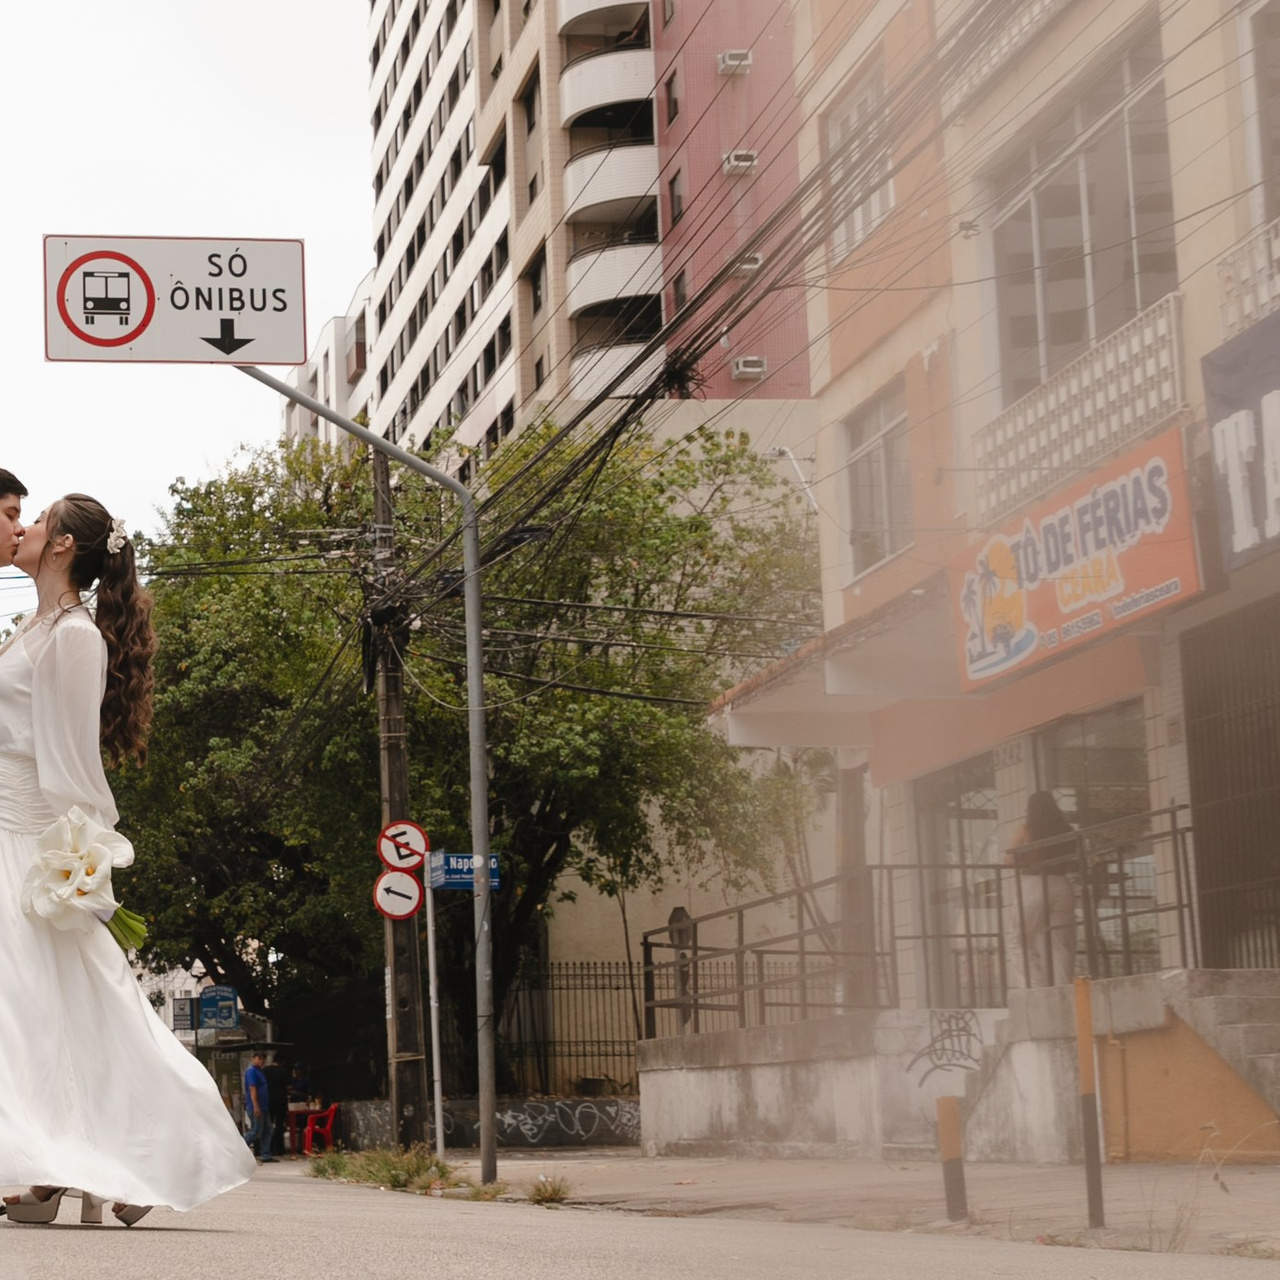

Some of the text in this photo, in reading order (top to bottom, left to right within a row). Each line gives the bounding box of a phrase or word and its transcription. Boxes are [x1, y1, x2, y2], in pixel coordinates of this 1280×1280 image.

[207, 248, 248, 278] SÓ
[170, 280, 288, 312] ÔNIBUS
[1011, 464, 1169, 589] TÔ DE FÉRIAS
[1058, 546, 1120, 607] CEARÁ
